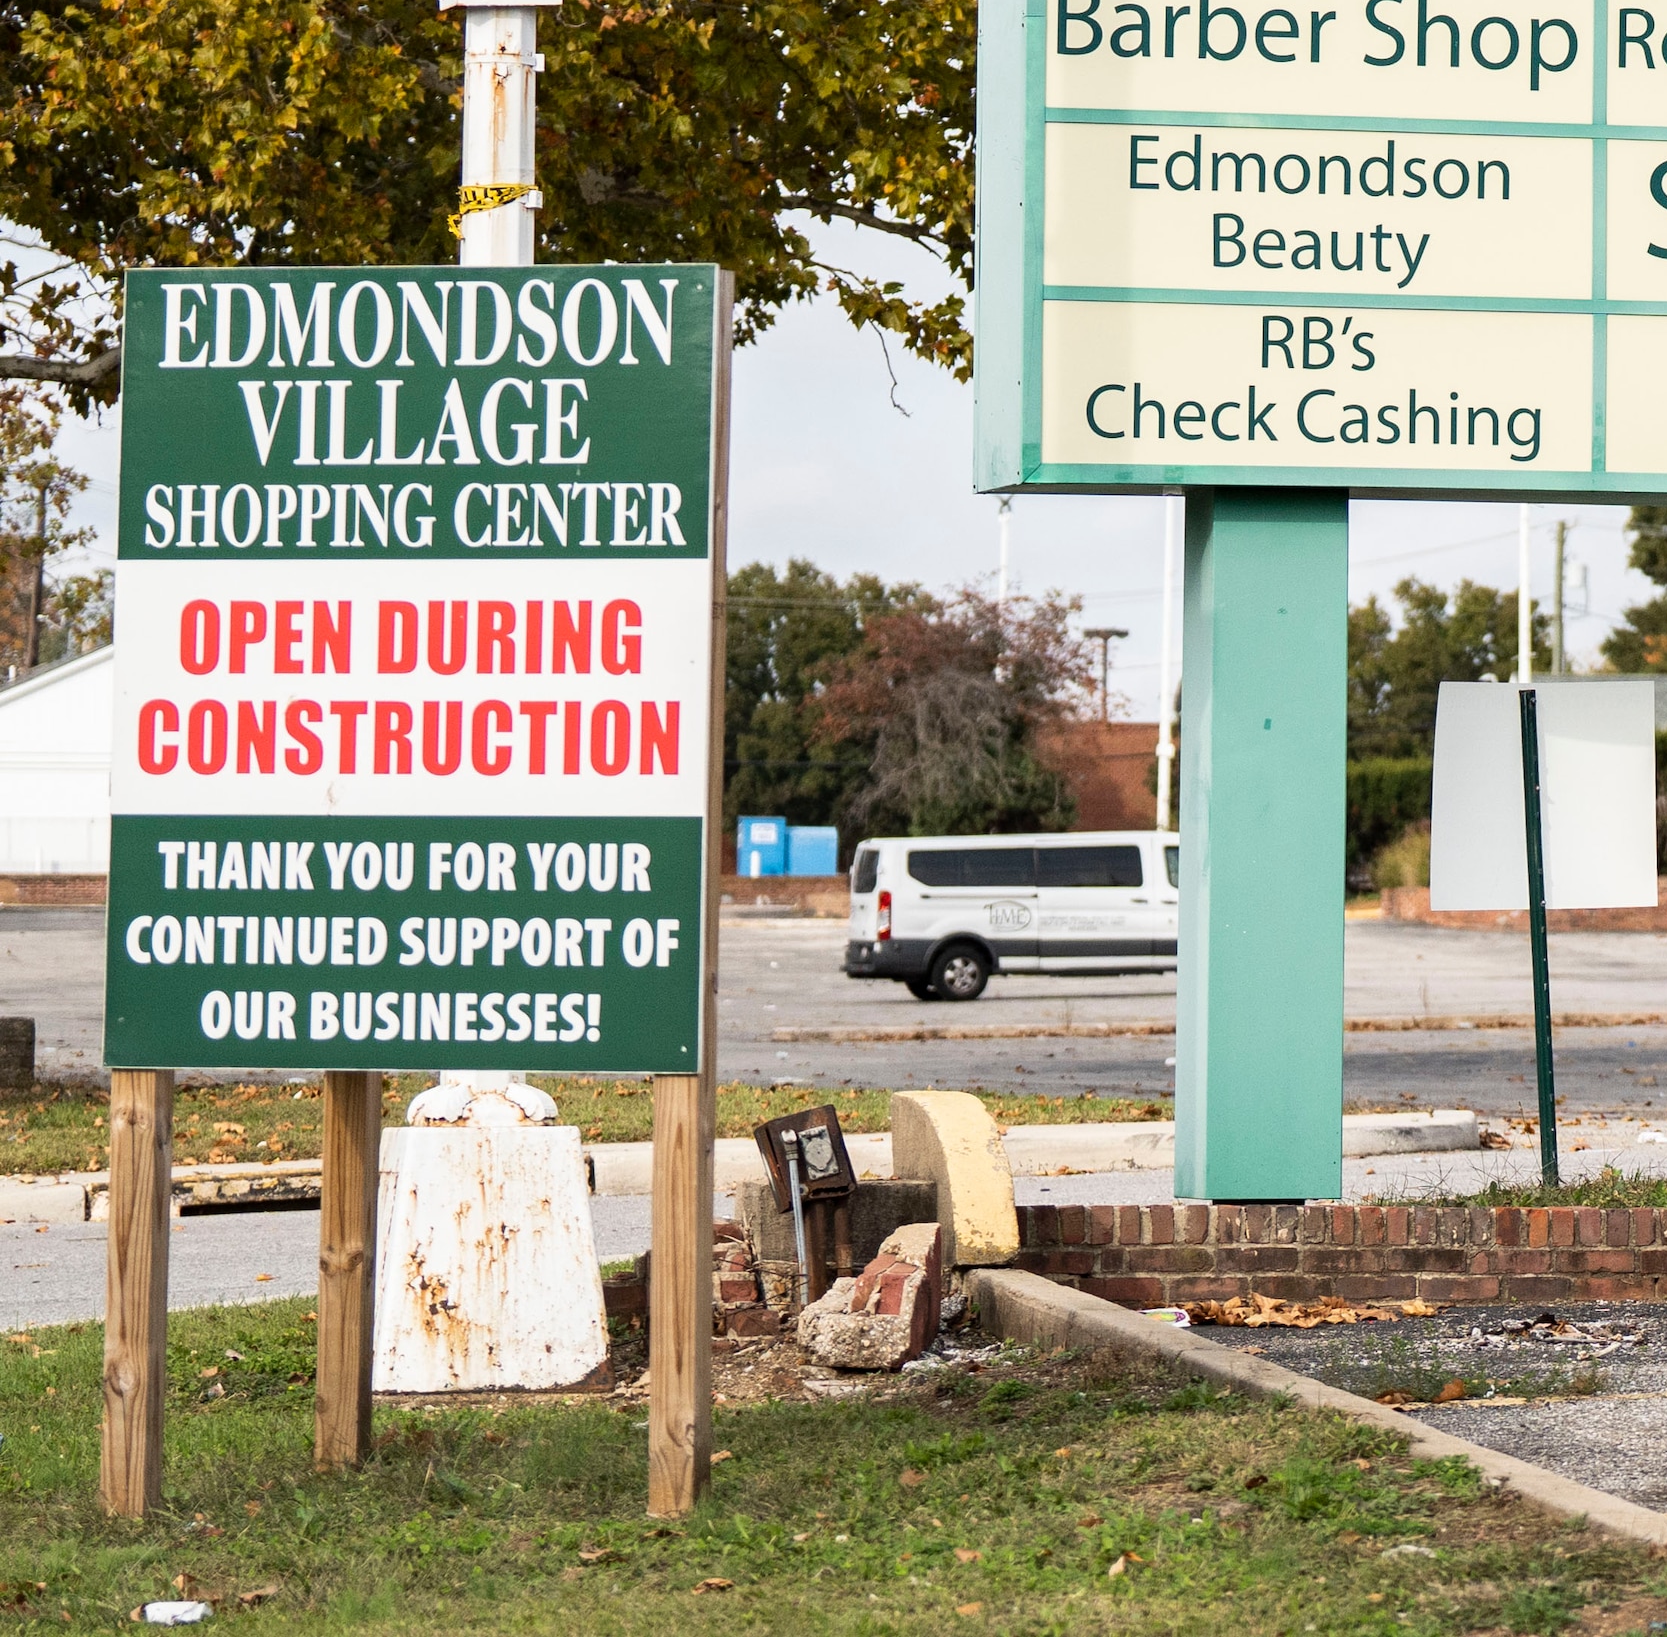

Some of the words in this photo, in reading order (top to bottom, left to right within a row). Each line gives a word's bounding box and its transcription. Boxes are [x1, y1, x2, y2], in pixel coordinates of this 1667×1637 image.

[1130, 134, 1509, 199] Edmondson
[1213, 213, 1430, 288] Beauty
[158, 278, 679, 368] EDMONDSON
[1262, 316, 1375, 371] RB's
[238, 378, 590, 466] VILLAGE
[1086, 383, 1277, 441] Check
[1297, 389, 1541, 461] Cashing
[145, 483, 436, 548] SHOPPING
[454, 482, 686, 547] CENTER
[180, 599, 351, 675] OPEN
[378, 599, 642, 675] DURING
[138, 699, 680, 776] CONSTRUCTION
[158, 842, 314, 890] THANK
[323, 842, 414, 891] YOU
[429, 842, 516, 891] FOR
[527, 842, 651, 892] YOUR
[126, 915, 387, 965] CONTINUED
[399, 917, 612, 966] SUPPORT
[622, 918, 679, 967] OF
[201, 990, 296, 1039] OUR
[310, 992, 601, 1042] BUSINESSES!
